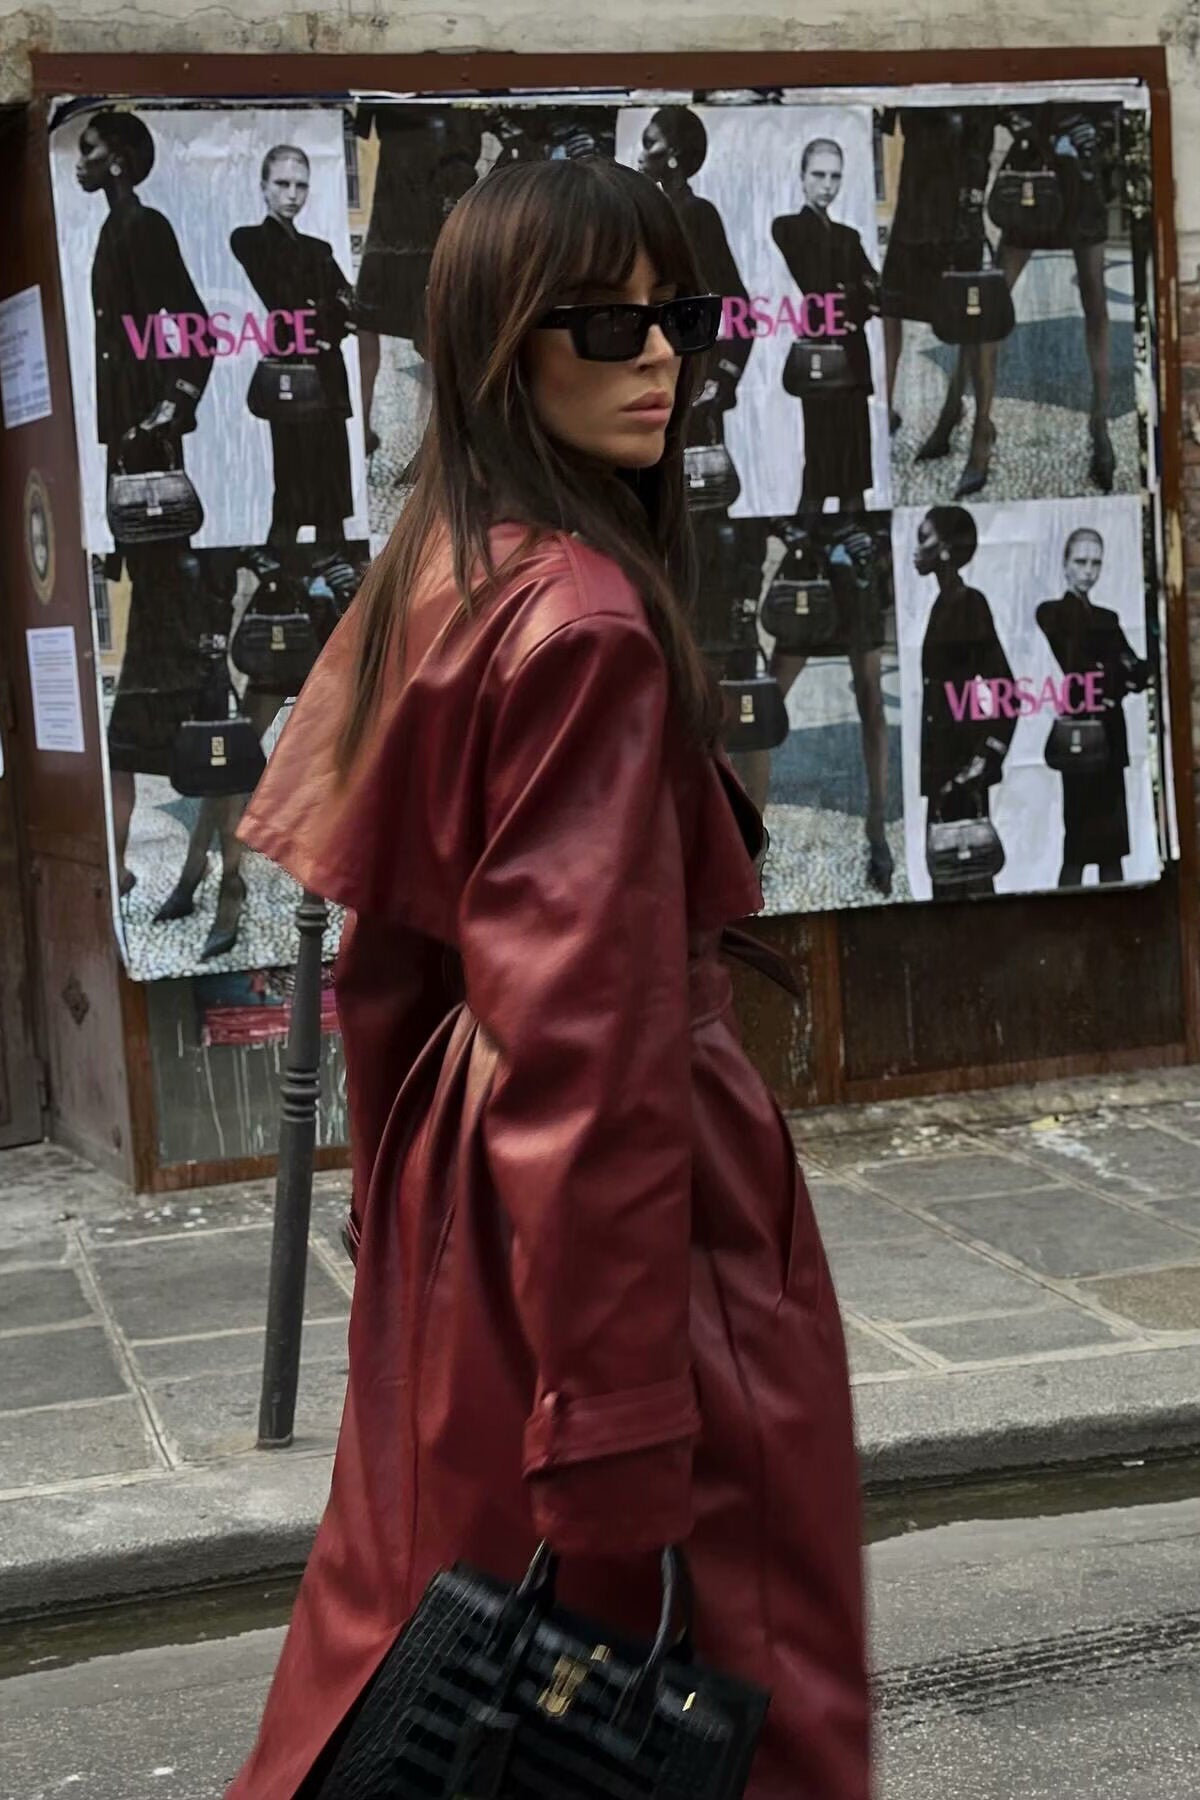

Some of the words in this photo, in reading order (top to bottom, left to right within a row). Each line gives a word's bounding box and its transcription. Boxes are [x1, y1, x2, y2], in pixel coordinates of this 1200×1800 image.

[121, 309, 320, 360] VERSACE
[715, 291, 848, 341] RSACE
[943, 671, 1106, 722] VERSACE
